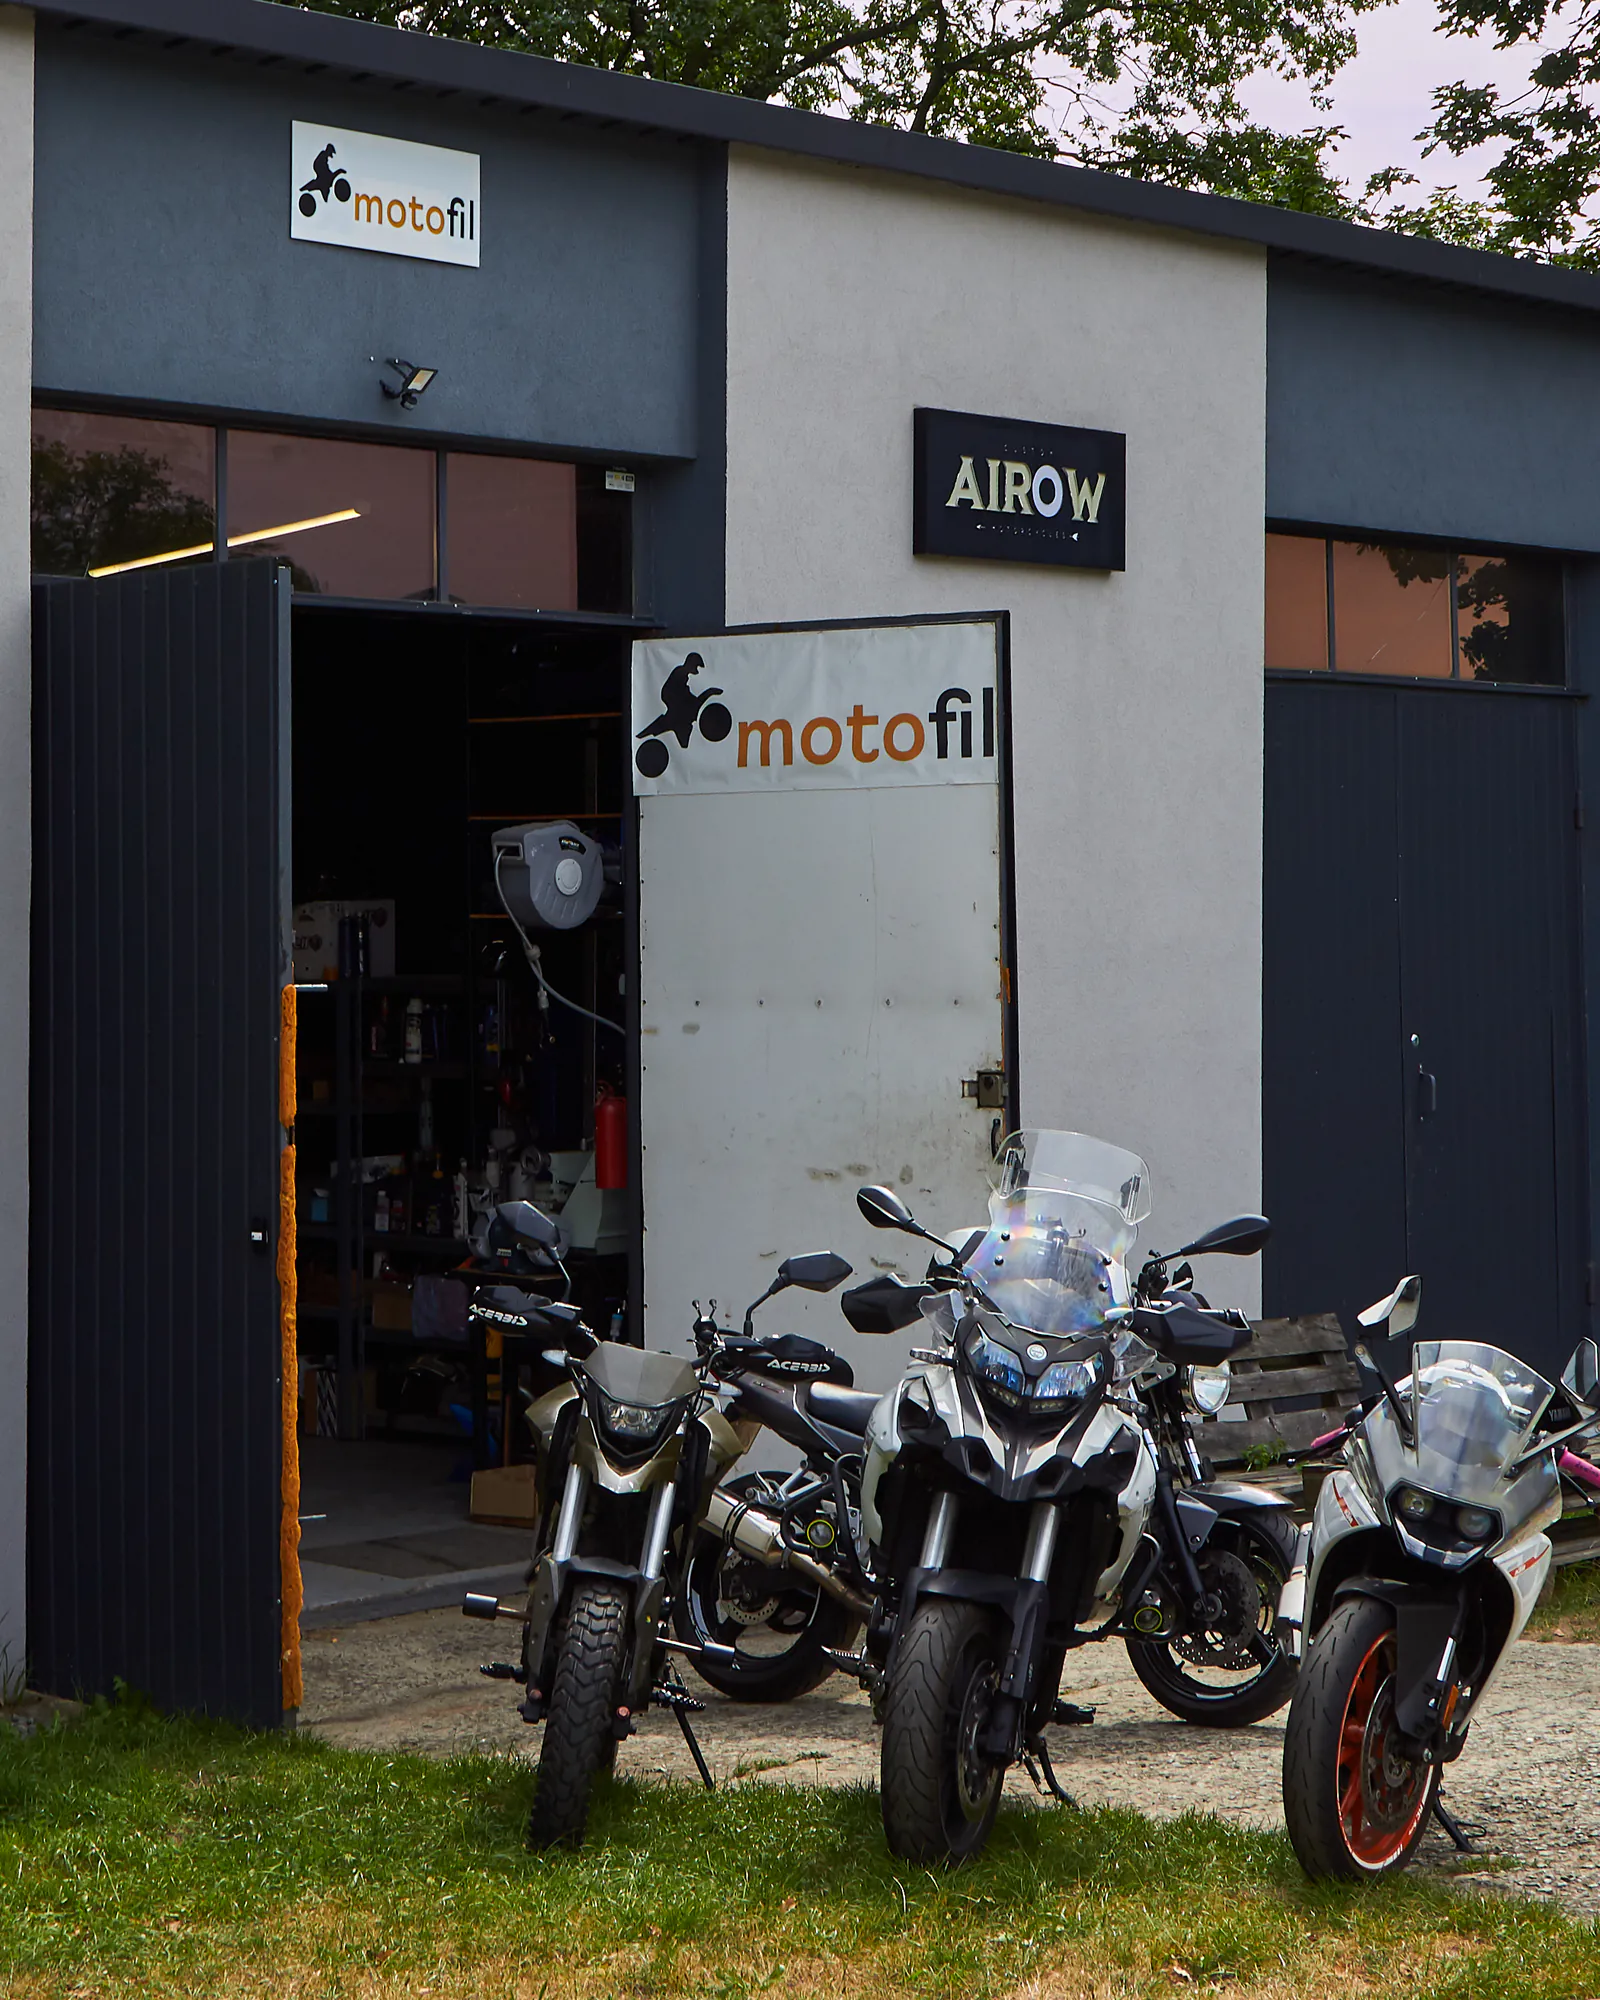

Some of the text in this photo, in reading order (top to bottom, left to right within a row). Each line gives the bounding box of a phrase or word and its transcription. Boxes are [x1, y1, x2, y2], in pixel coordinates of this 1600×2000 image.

[354, 191, 474, 240] motofil
[1003, 443, 1054, 457] CSTO
[945, 455, 1107, 524] AIROW
[991, 525, 1066, 540] OTORCYCLES
[737, 687, 995, 768] motofil
[468, 1302, 529, 1327] ACERBIS
[766, 1358, 831, 1373] ACERBIS
